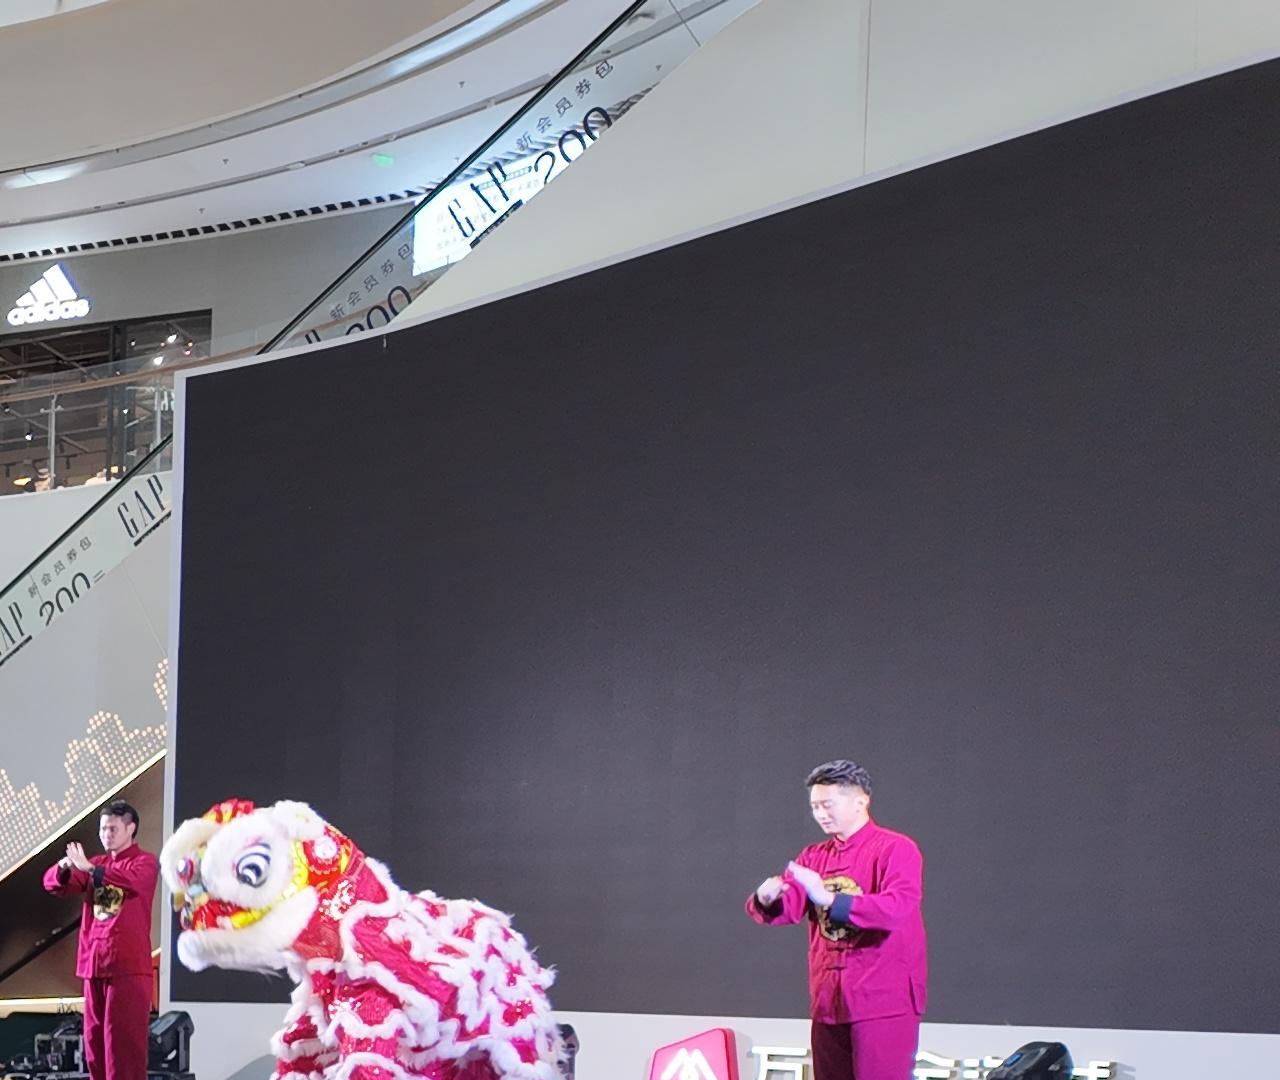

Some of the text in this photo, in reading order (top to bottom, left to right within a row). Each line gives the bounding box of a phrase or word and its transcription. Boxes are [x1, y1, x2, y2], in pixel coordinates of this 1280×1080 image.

[516, 59, 615, 152] 新会员券包
[6, 299, 91, 326] adidas
[329, 243, 413, 320] 新会员券包
[117, 475, 166, 538] GAP
